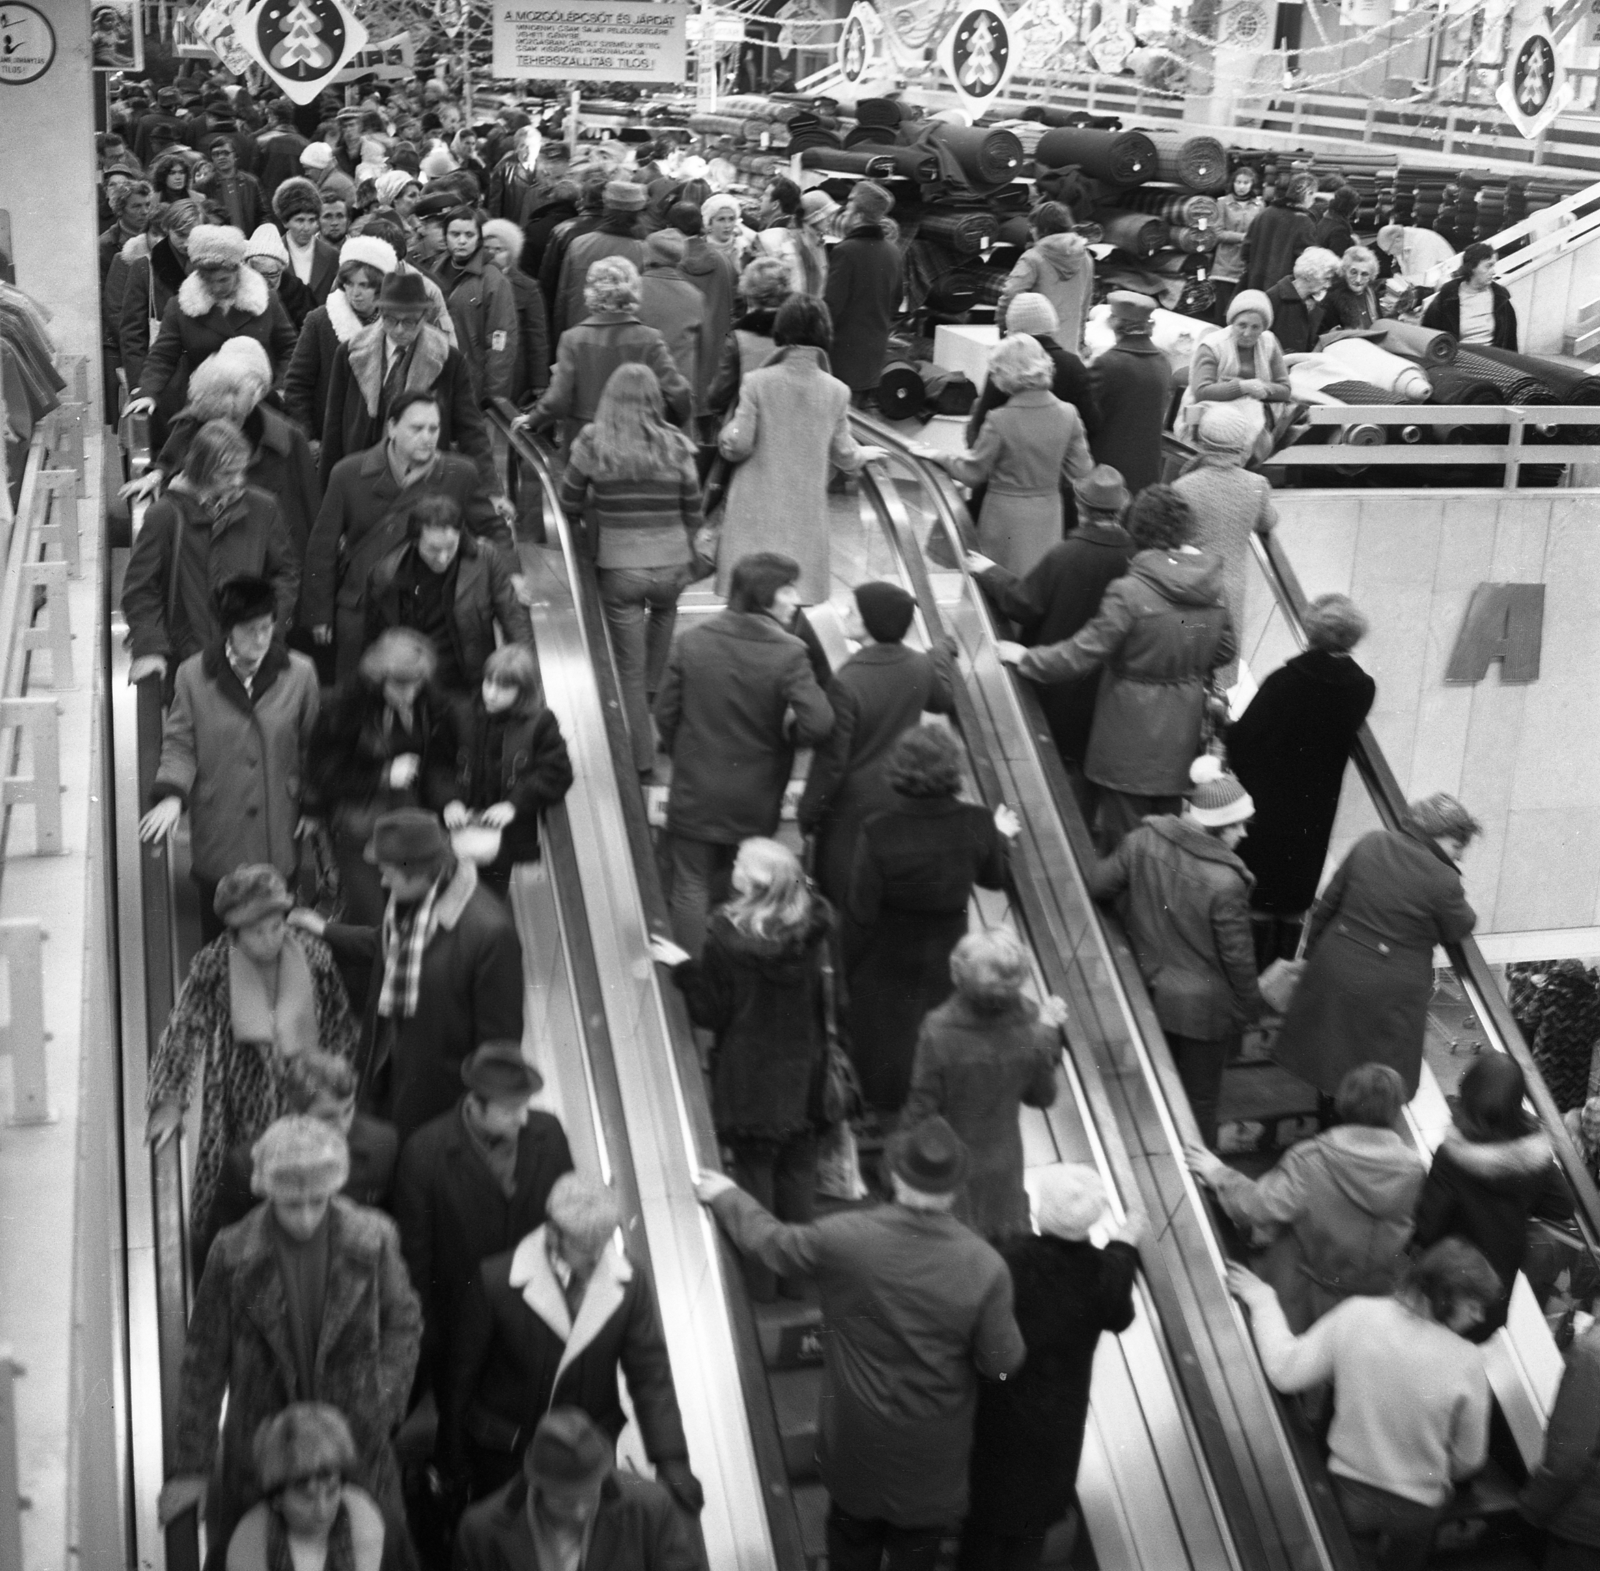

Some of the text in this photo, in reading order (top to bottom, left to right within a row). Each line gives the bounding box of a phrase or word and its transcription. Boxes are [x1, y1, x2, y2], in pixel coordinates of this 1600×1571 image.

[504, 10, 512, 19] A
[616, 12, 631, 24] ÉS
[617, 57, 655, 68] TILOS!
[1445, 582, 1546, 686] A
